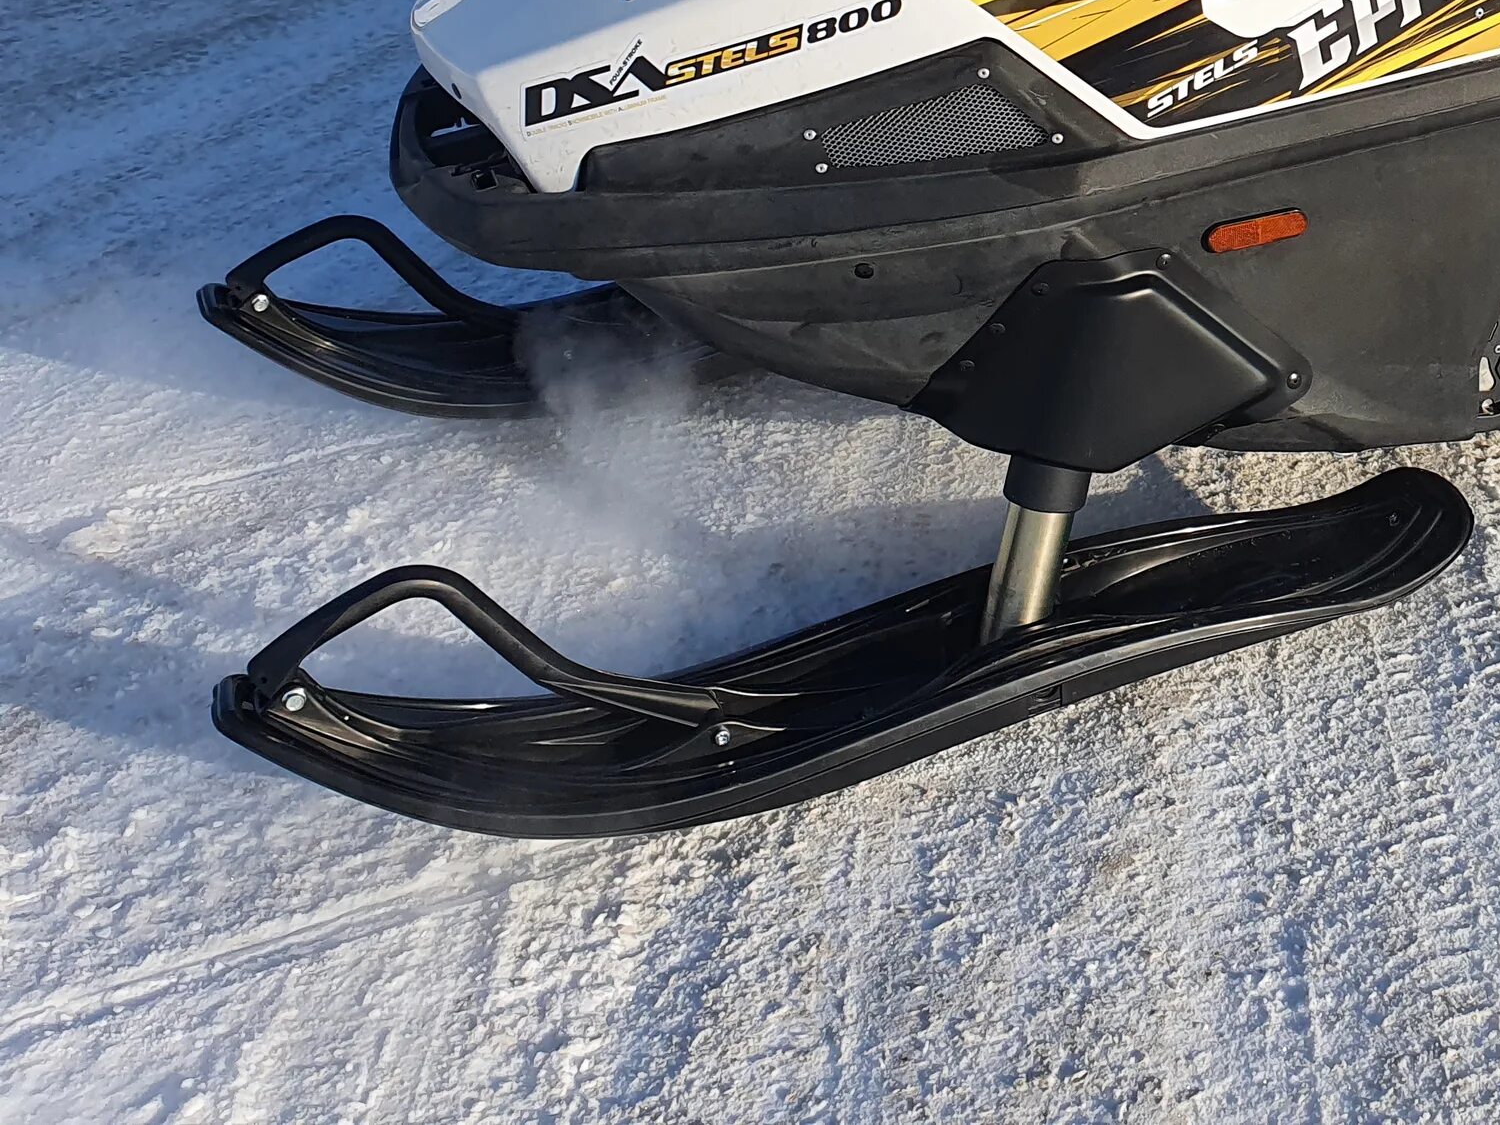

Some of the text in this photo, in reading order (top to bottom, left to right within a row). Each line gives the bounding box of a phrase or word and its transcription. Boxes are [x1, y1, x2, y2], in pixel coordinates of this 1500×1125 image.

[609, 39, 643, 86] FOUR-STROKE
[665, 27, 801, 86] STELS
[1146, 39, 1259, 119] STELS
